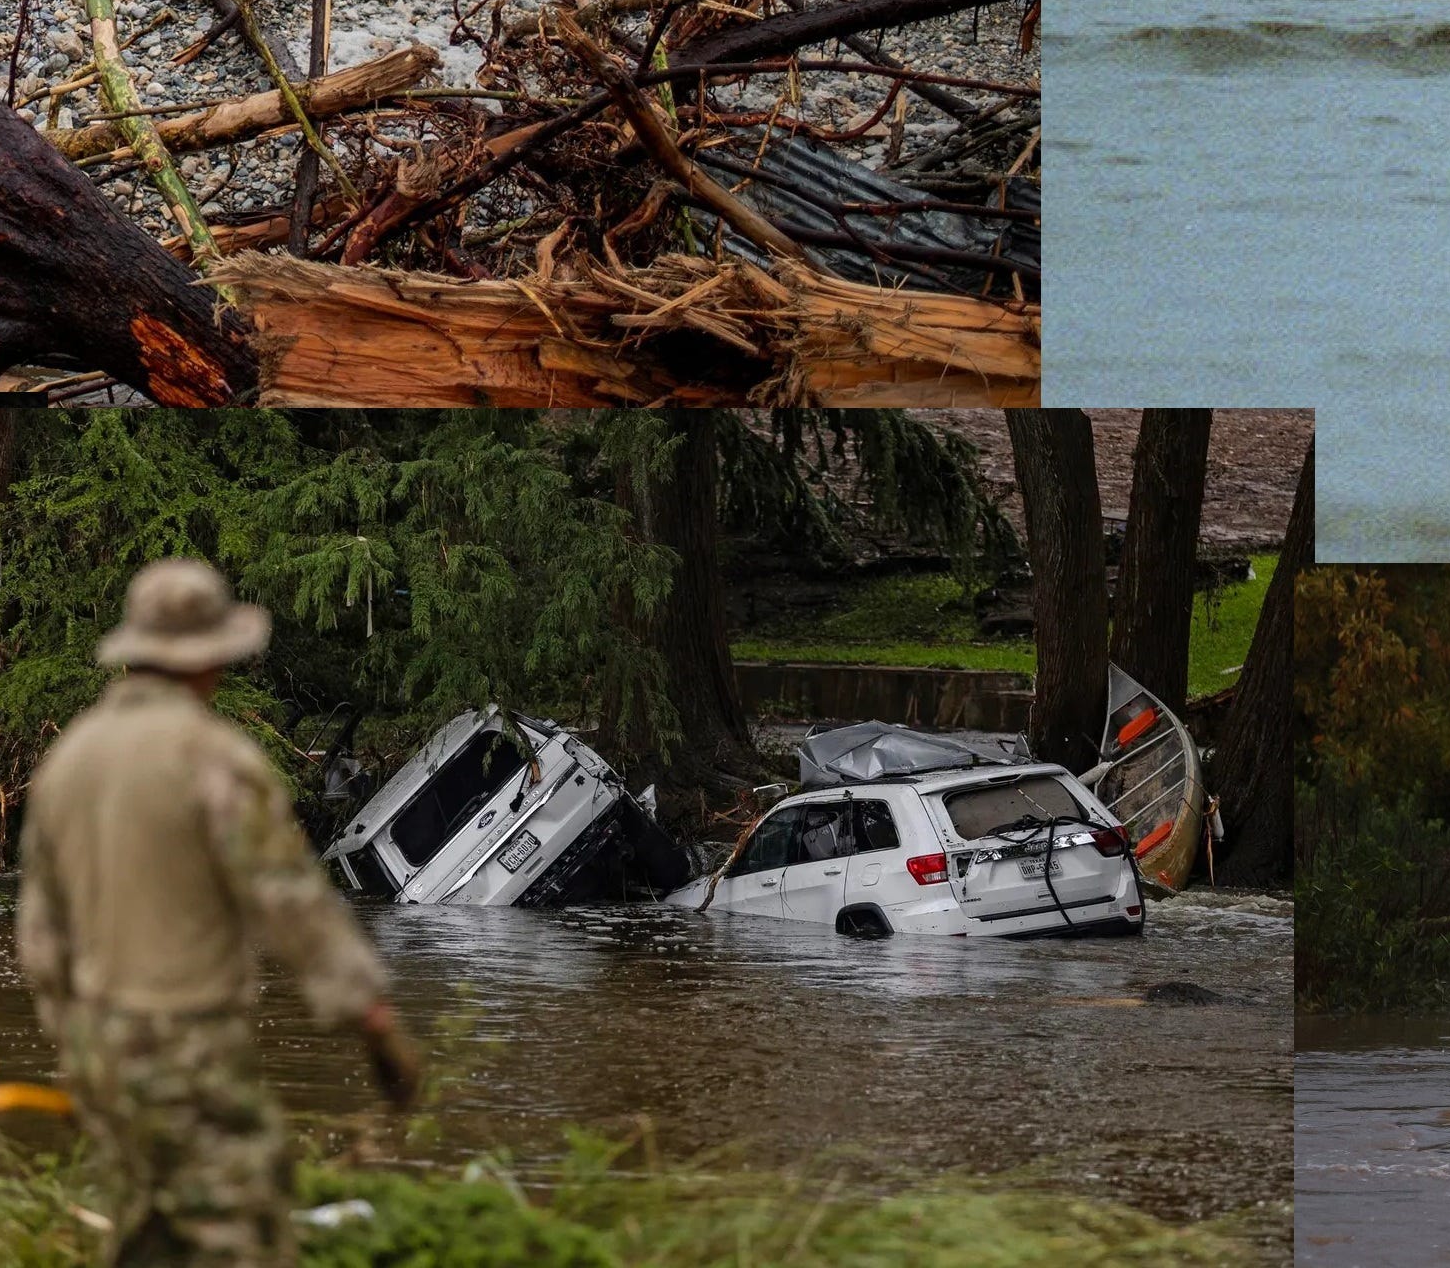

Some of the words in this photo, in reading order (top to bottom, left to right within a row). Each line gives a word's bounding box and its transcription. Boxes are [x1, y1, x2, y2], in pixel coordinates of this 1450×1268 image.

[481, 812, 496, 826] Ford
[458, 790, 540, 874] EXPEDITION
[1021, 861, 1060, 874] DHP-545
